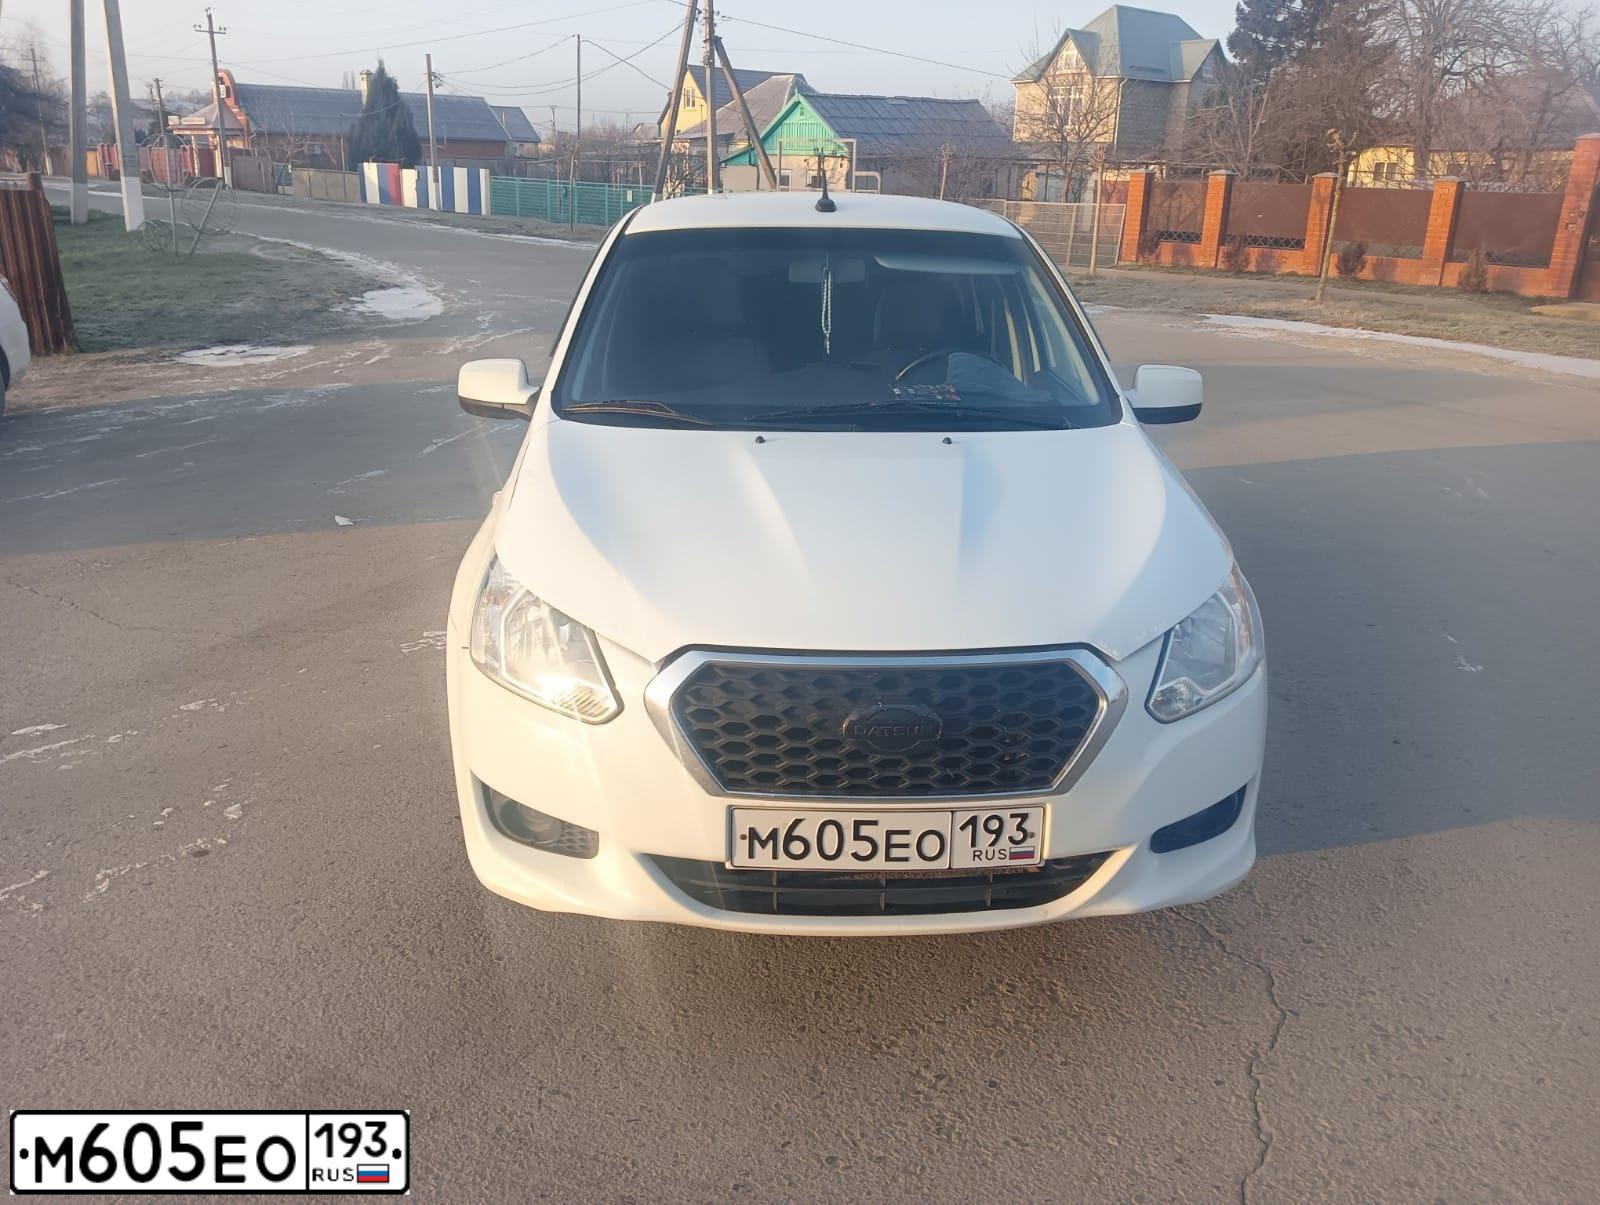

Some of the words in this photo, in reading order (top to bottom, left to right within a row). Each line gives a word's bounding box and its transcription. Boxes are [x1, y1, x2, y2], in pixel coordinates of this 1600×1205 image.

[747, 817, 946, 863] М605ЕО
[958, 812, 1030, 848] 193
[972, 848, 1008, 862] RUS
